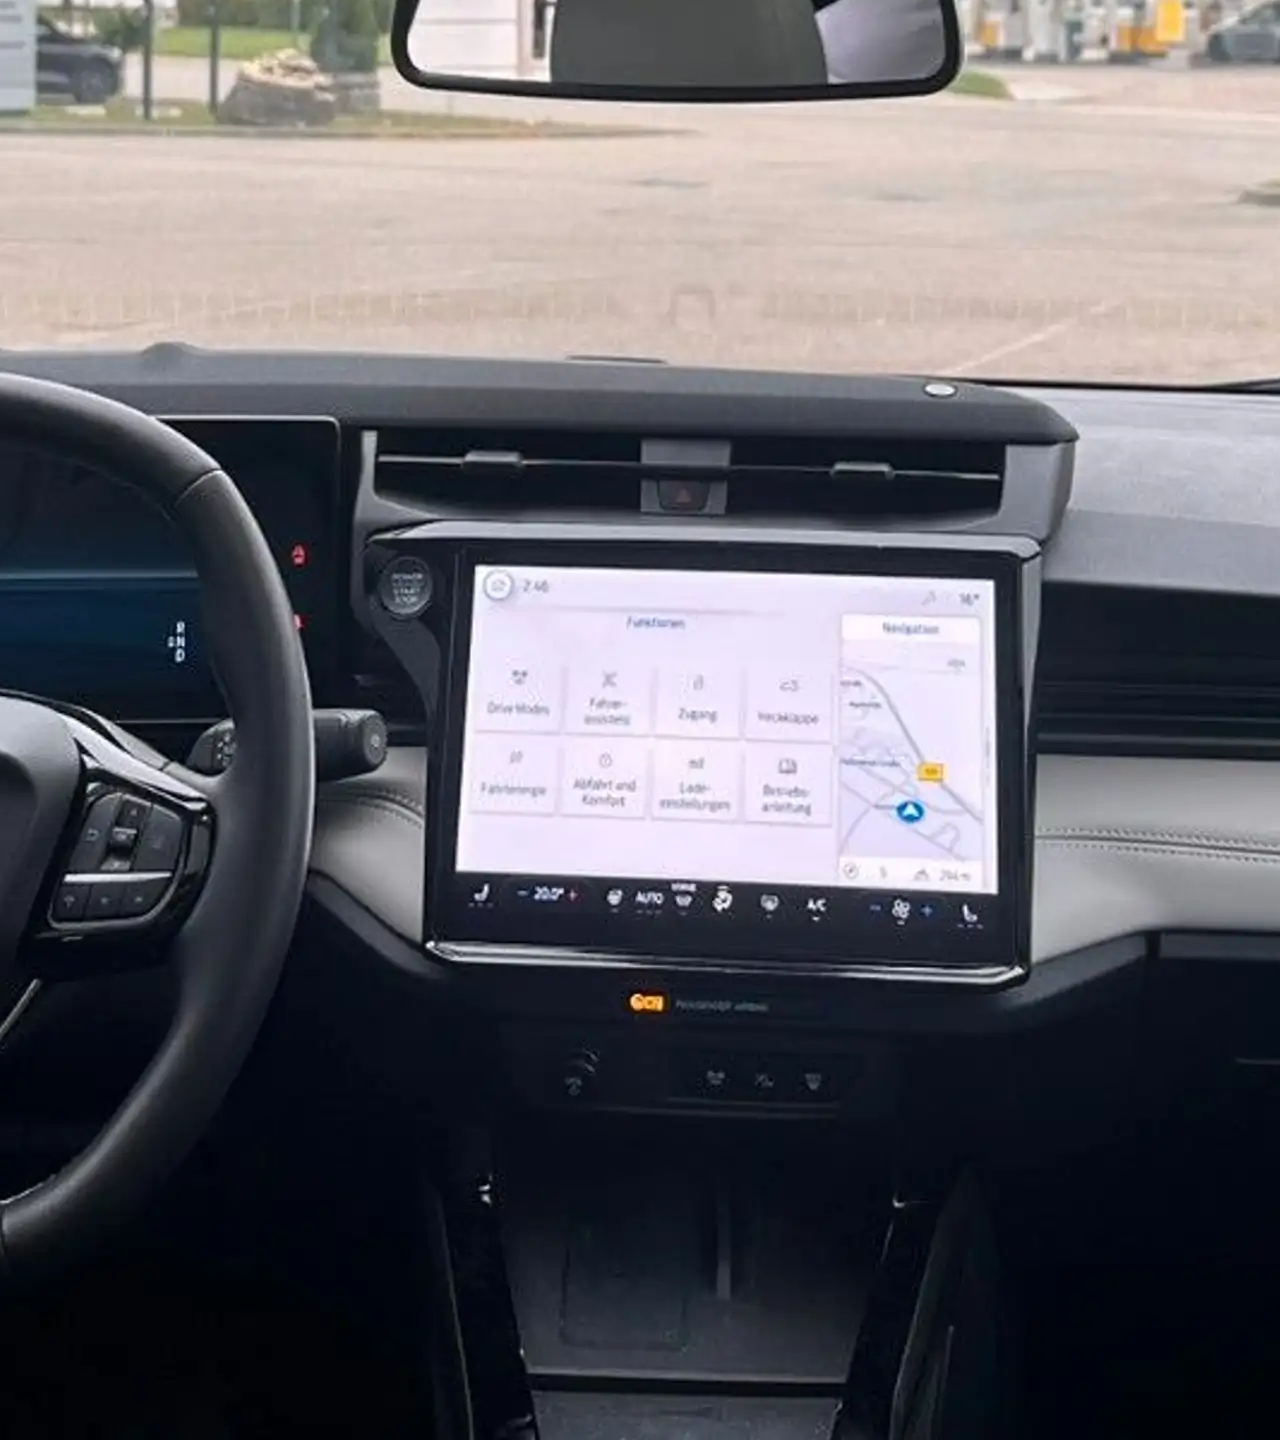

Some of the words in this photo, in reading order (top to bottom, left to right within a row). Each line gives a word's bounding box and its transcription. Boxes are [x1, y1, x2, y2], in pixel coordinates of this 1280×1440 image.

[626, 616, 686, 630] Funktionen
[882, 622, 940, 637] Navigation
[678, 706, 718, 724] Zugang
[635, 890, 664, 905] AUTO
